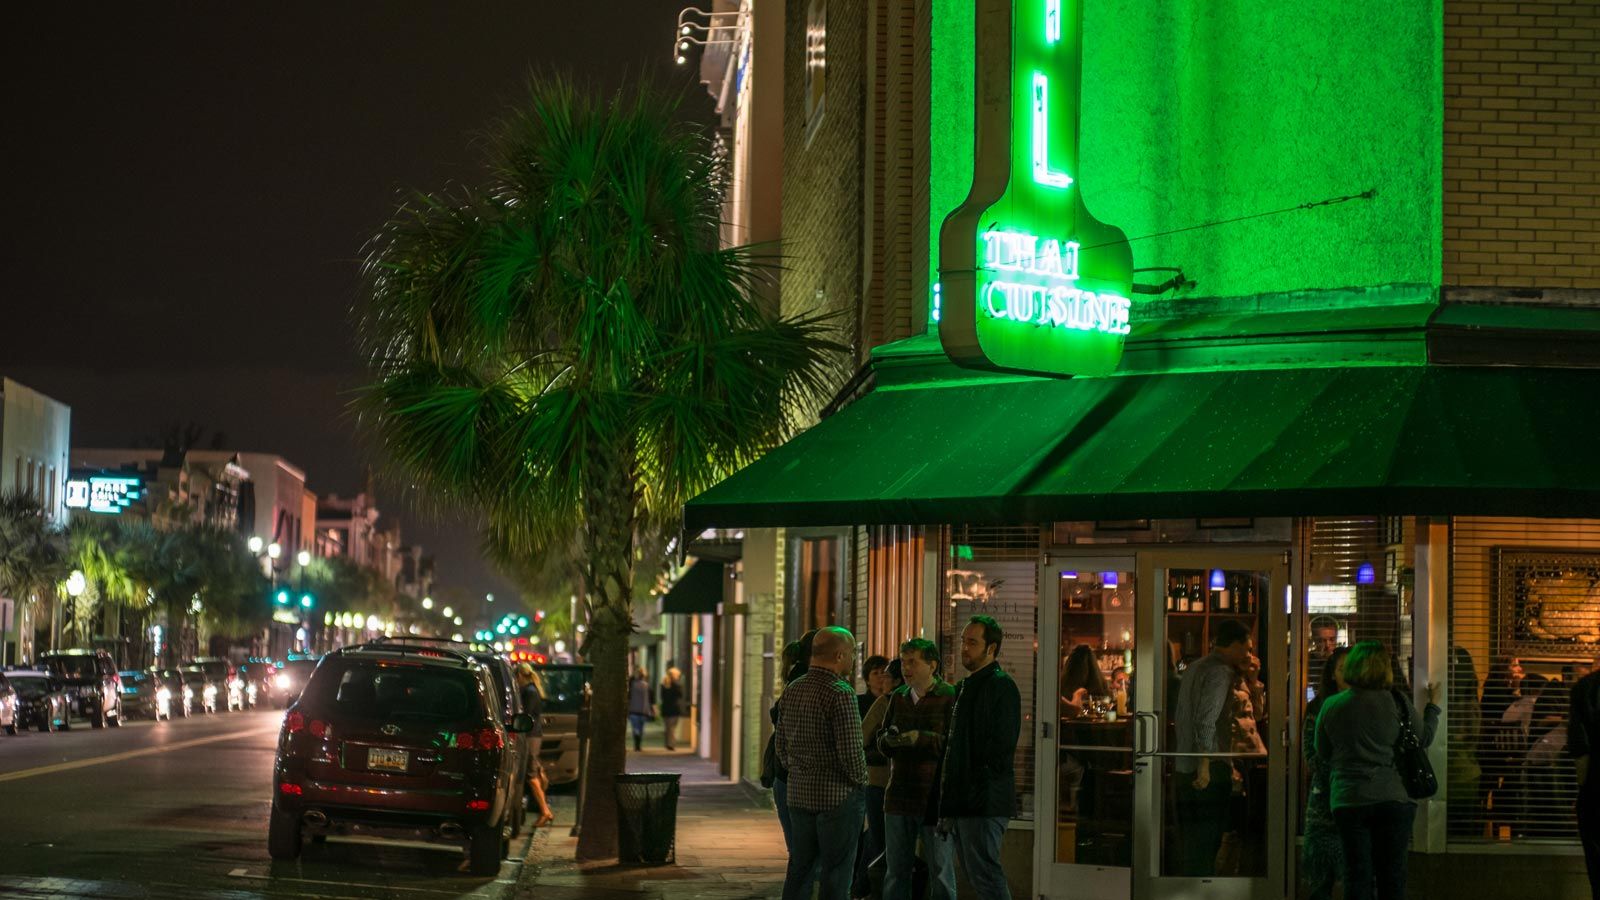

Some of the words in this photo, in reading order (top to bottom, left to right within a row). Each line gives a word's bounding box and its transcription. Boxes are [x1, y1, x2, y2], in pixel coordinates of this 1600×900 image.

[983, 230, 1081, 281] THAI
[981, 280, 1132, 335] CUISINE
[970, 602, 1018, 613] BASIL
[1002, 632, 1024, 640] Hours
